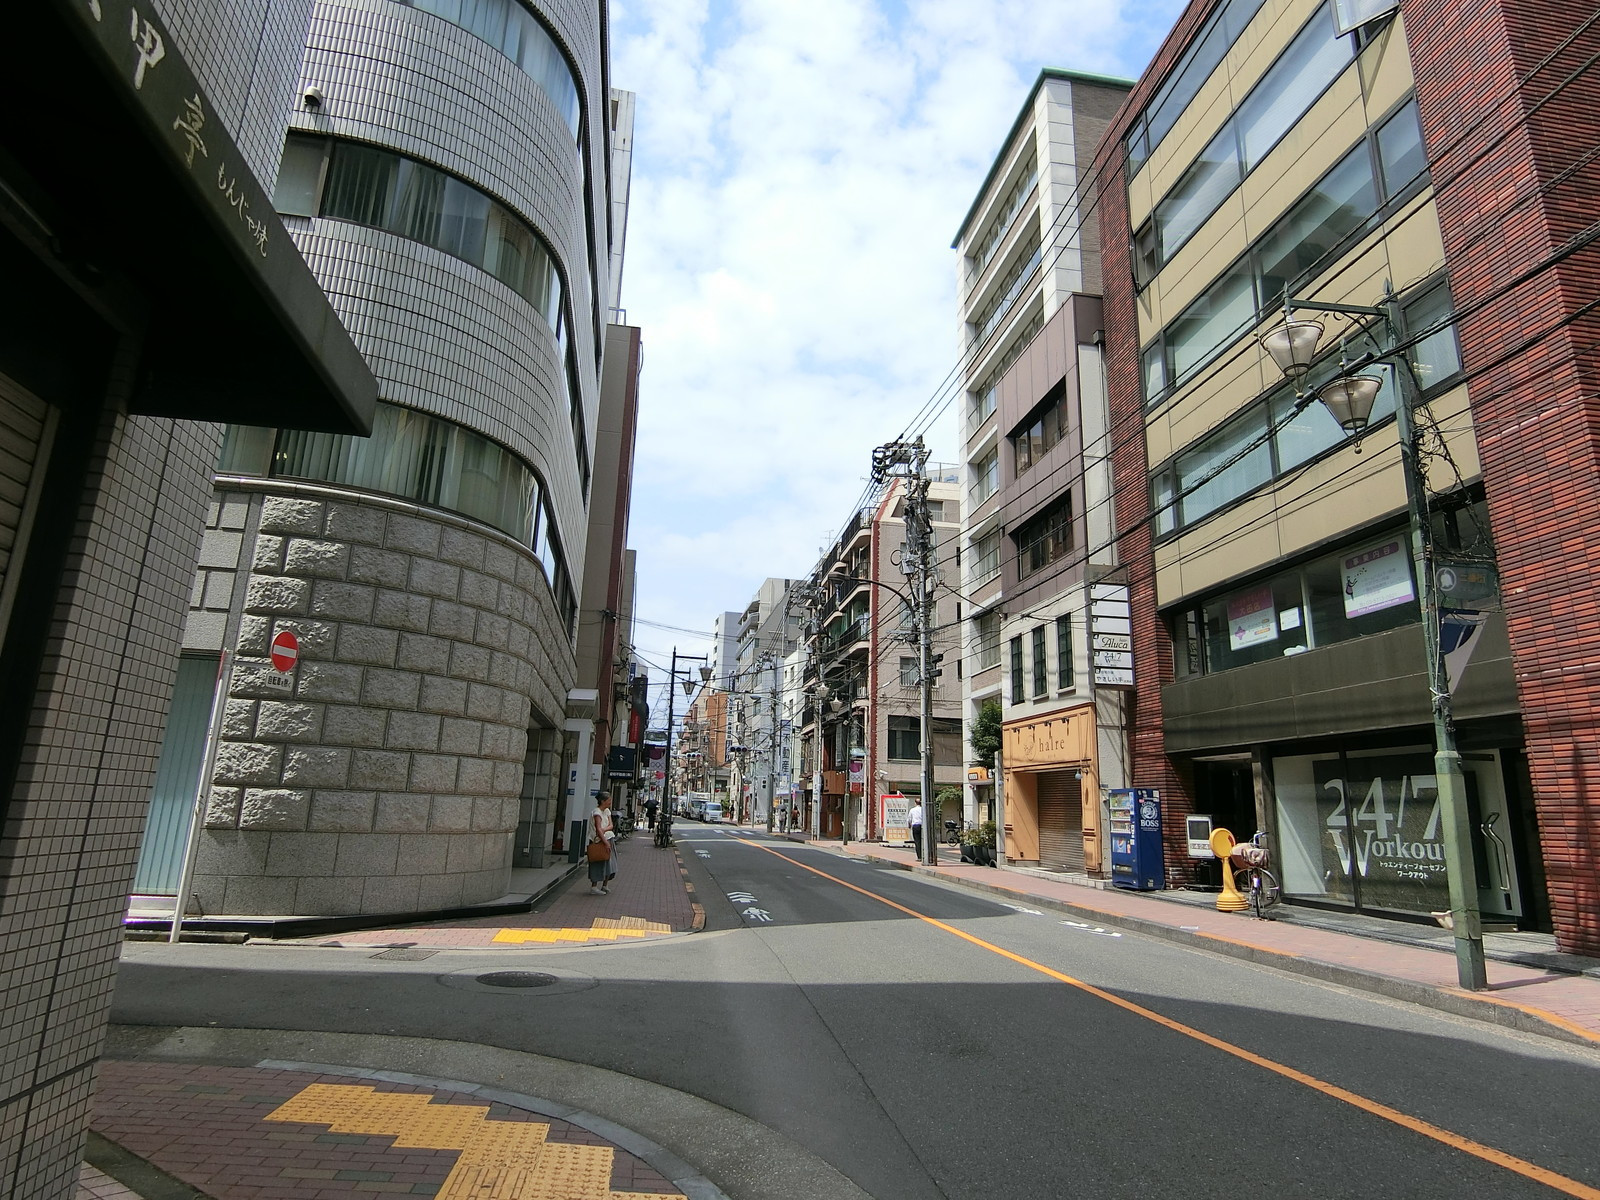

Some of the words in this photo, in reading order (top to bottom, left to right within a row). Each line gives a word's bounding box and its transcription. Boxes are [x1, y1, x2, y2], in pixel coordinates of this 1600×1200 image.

[783, 733, 791, 773] 不動産
[1324, 774, 1440, 839] 24/7
[1140, 819, 1159, 827] BOSS
[1397, 870, 1429, 880] ワークアウト
